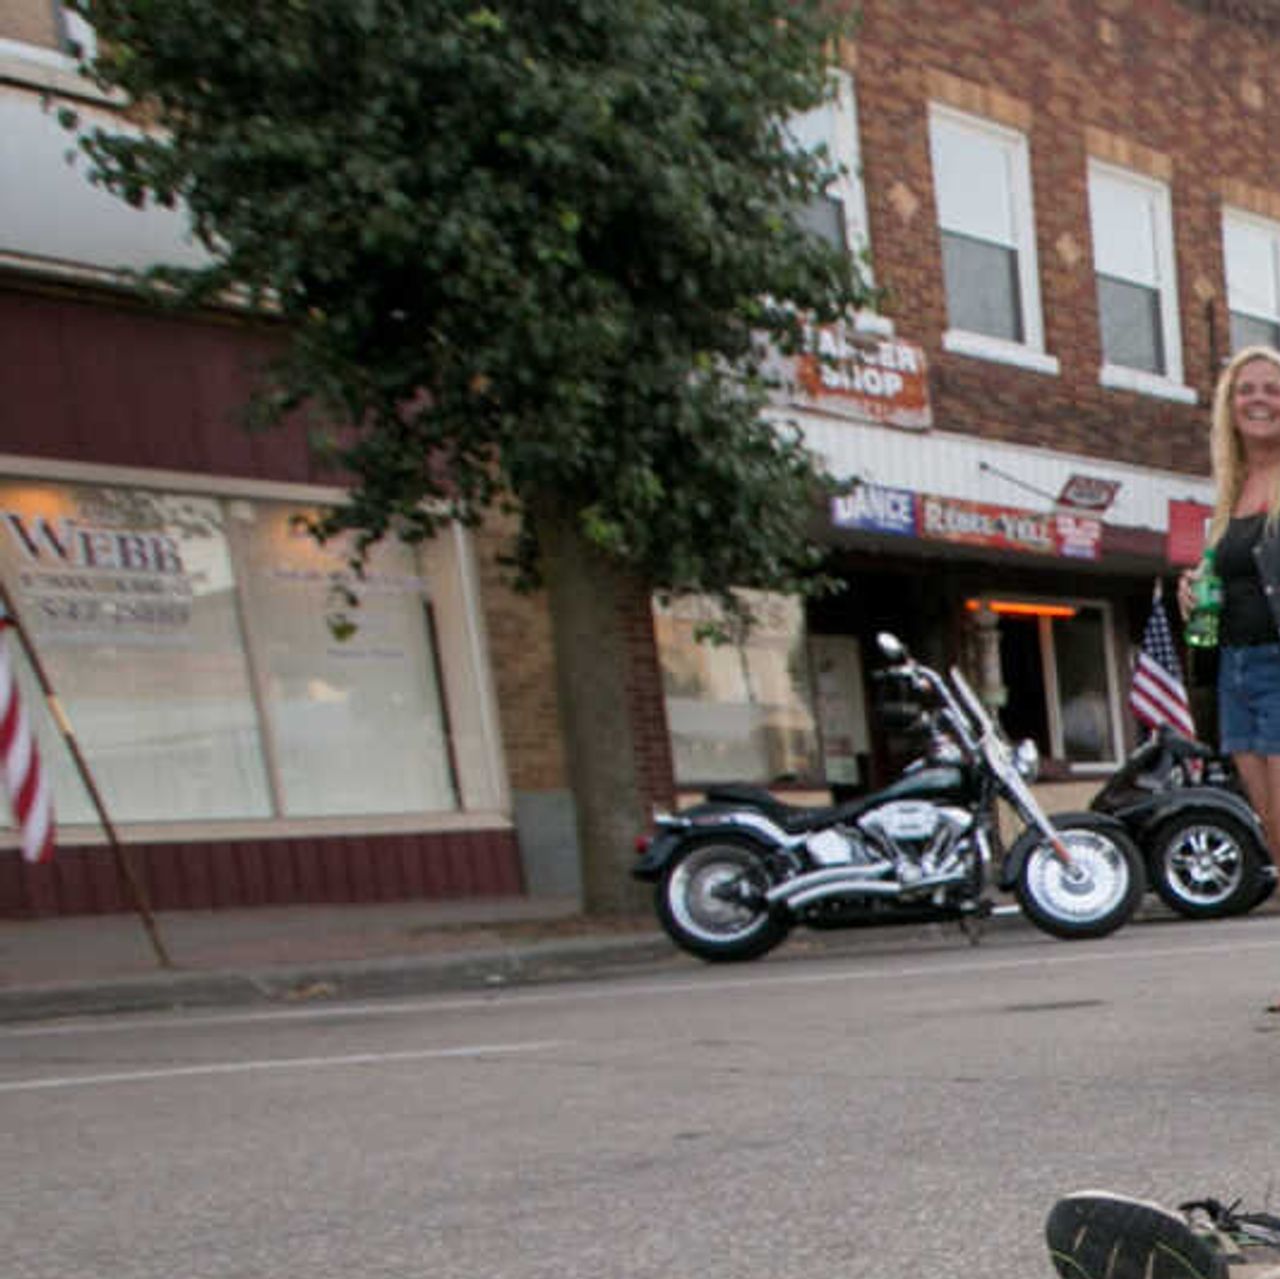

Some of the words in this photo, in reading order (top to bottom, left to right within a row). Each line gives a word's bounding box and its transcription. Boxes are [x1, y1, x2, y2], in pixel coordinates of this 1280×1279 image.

[819, 362, 903, 400] SHOP
[833, 485, 914, 525] DANCE
[5, 514, 184, 573] WEBB
